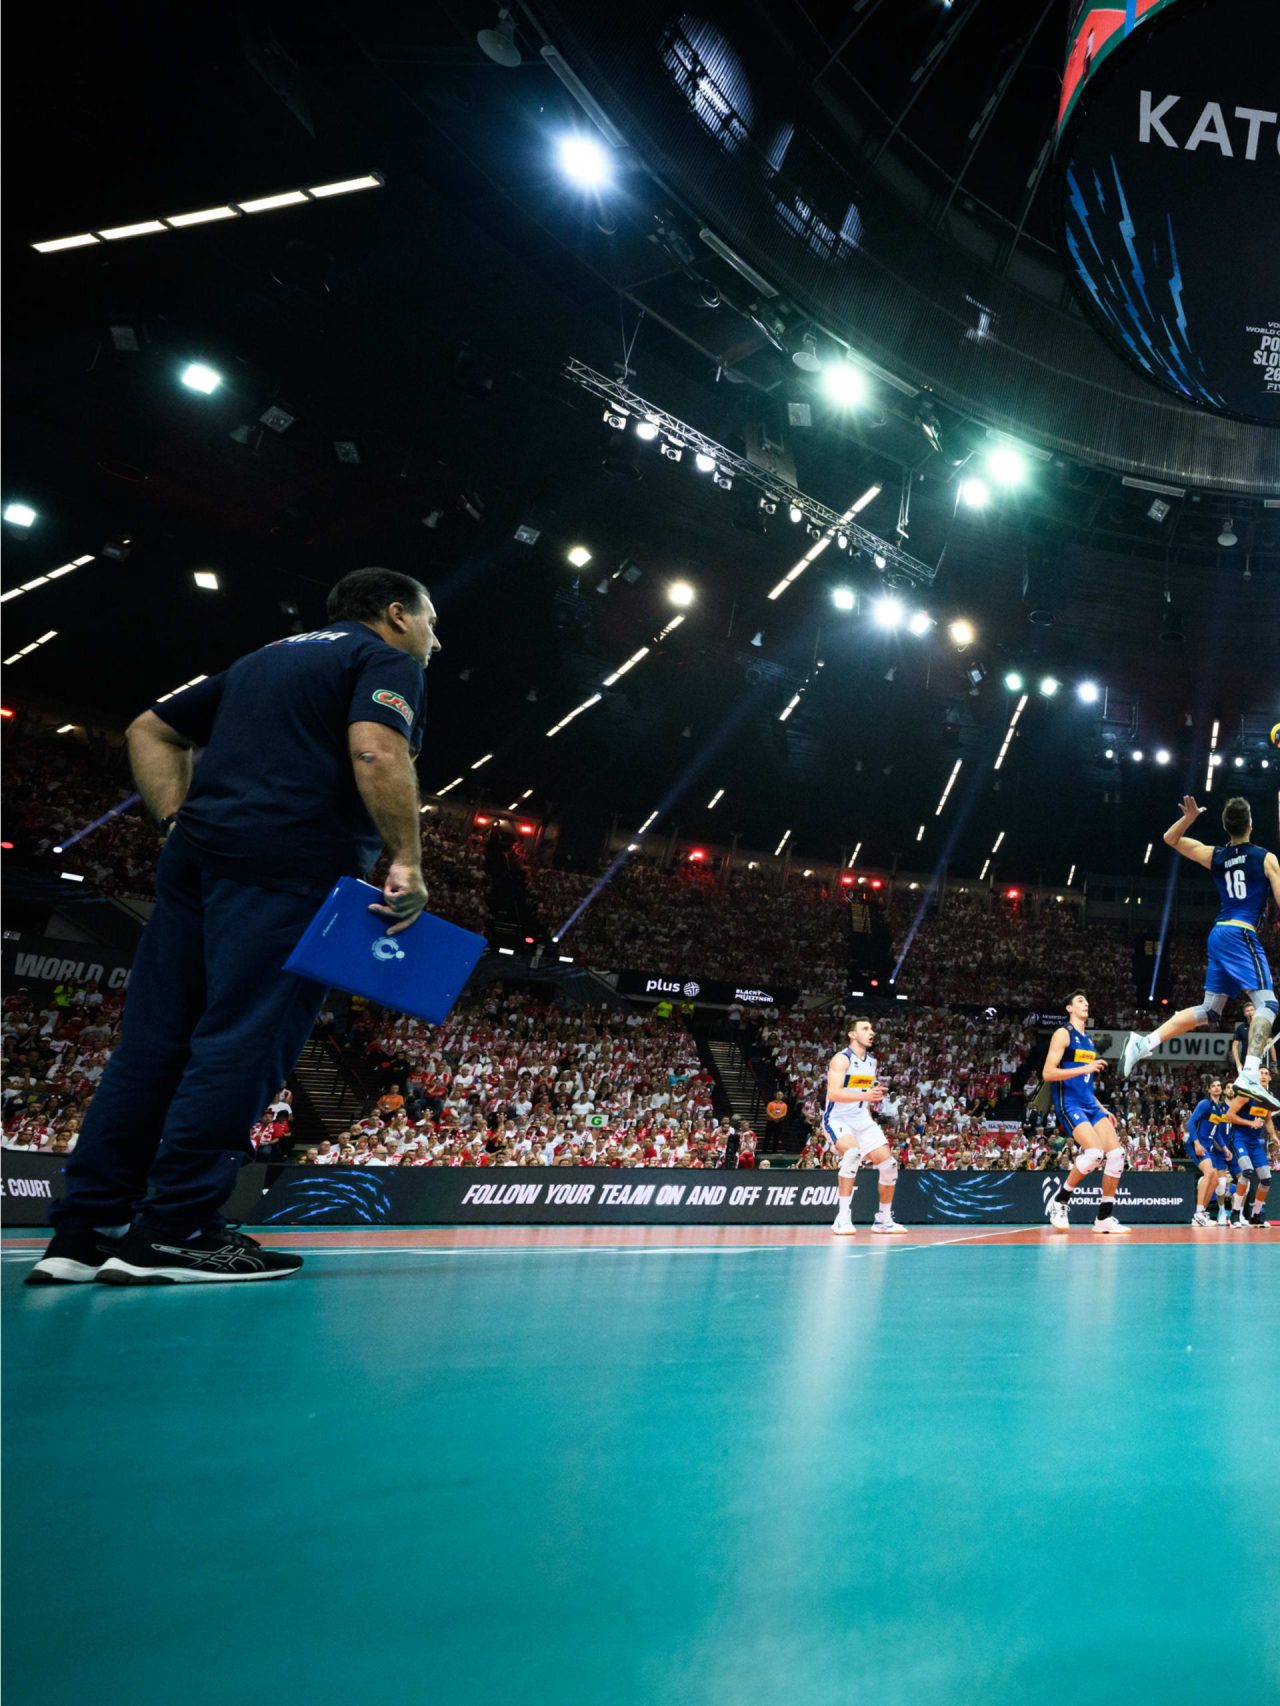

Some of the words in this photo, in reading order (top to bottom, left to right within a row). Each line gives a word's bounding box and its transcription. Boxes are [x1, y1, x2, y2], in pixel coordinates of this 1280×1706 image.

[1245, 325, 1276, 336] WORLD
[1224, 868, 1248, 900] 16
[14, 952, 104, 984] WORLD
[646, 978, 681, 993] plus
[591, 1115, 603, 1126] G
[7, 1178, 52, 1198] COURT
[461, 1184, 543, 1205] FOLLOW
[544, 1184, 595, 1205] YOUR
[598, 1184, 656, 1205] TEAM
[655, 1185, 686, 1206] ON
[685, 1185, 727, 1206] AND
[729, 1186, 763, 1206] OFF
[765, 1186, 799, 1206] THE
[1112, 1197, 1183, 1206] HAMPIONSHIP
